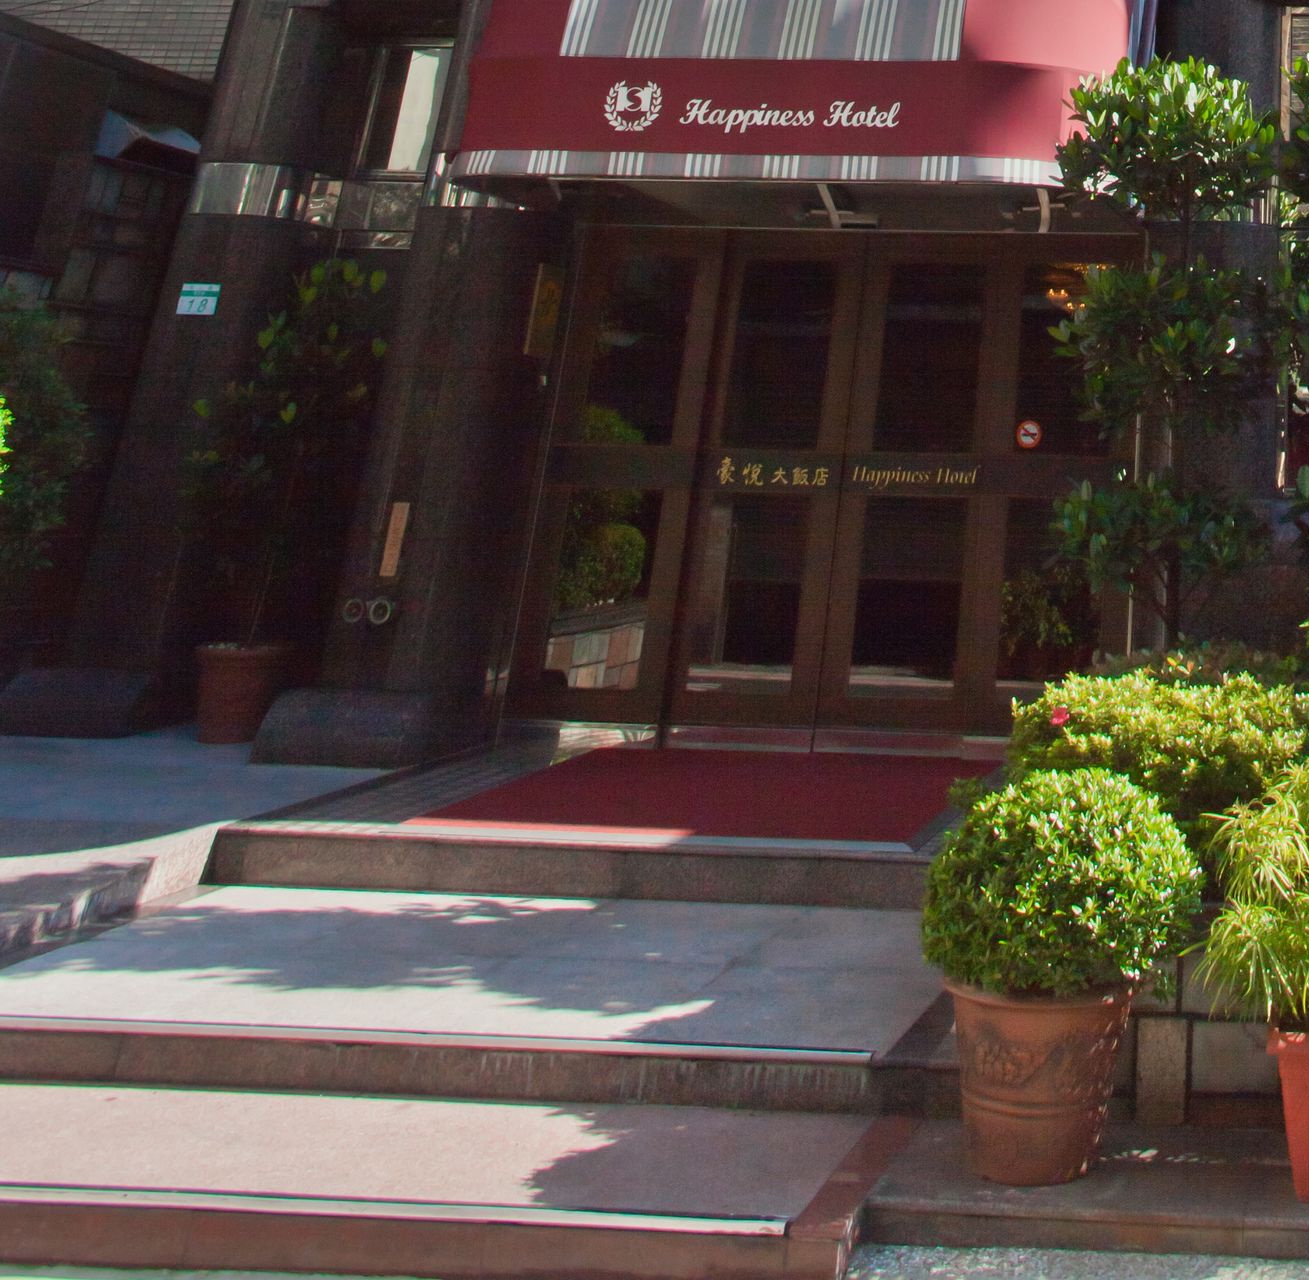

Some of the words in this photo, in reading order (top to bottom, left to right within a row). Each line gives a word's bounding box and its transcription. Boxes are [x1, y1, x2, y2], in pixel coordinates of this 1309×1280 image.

[680, 98, 815, 133] Happiness
[824, 100, 900, 127] Hotel
[187, 298, 208, 313] 18
[851, 464, 931, 489] Happiness
[936, 465, 980, 485] Hotel
